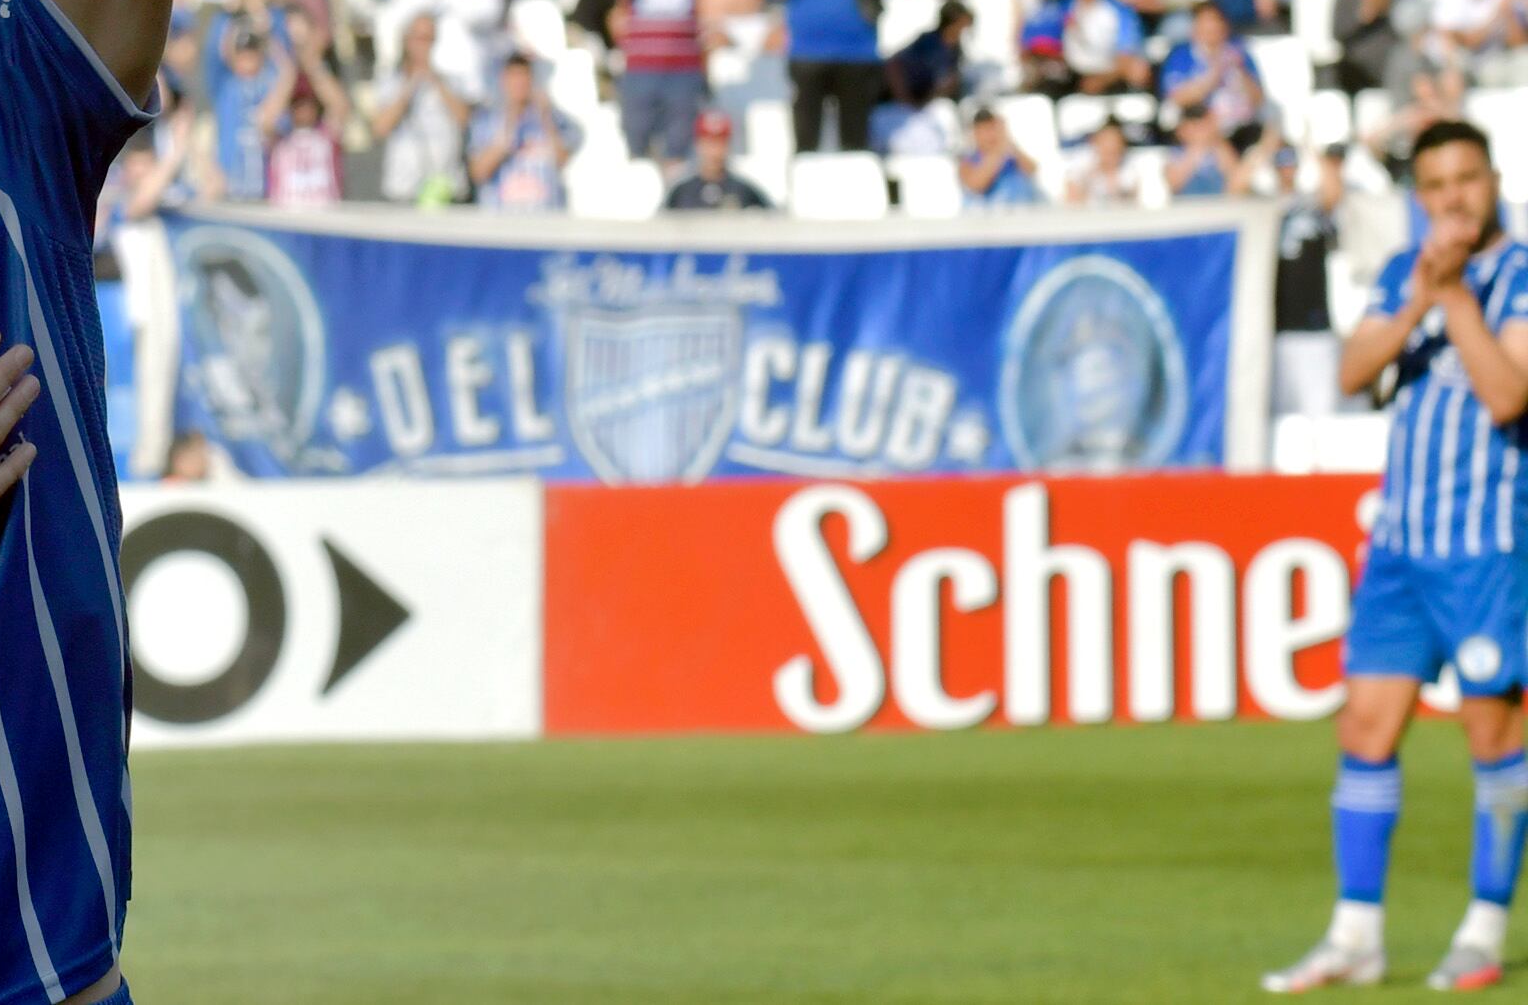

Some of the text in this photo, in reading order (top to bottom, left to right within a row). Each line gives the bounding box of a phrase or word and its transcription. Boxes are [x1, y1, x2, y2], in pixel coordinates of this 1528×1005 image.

[371, 332, 554, 453] DEL
[740, 338, 957, 468] CLUB
[773, 480, 1364, 732] Schne
